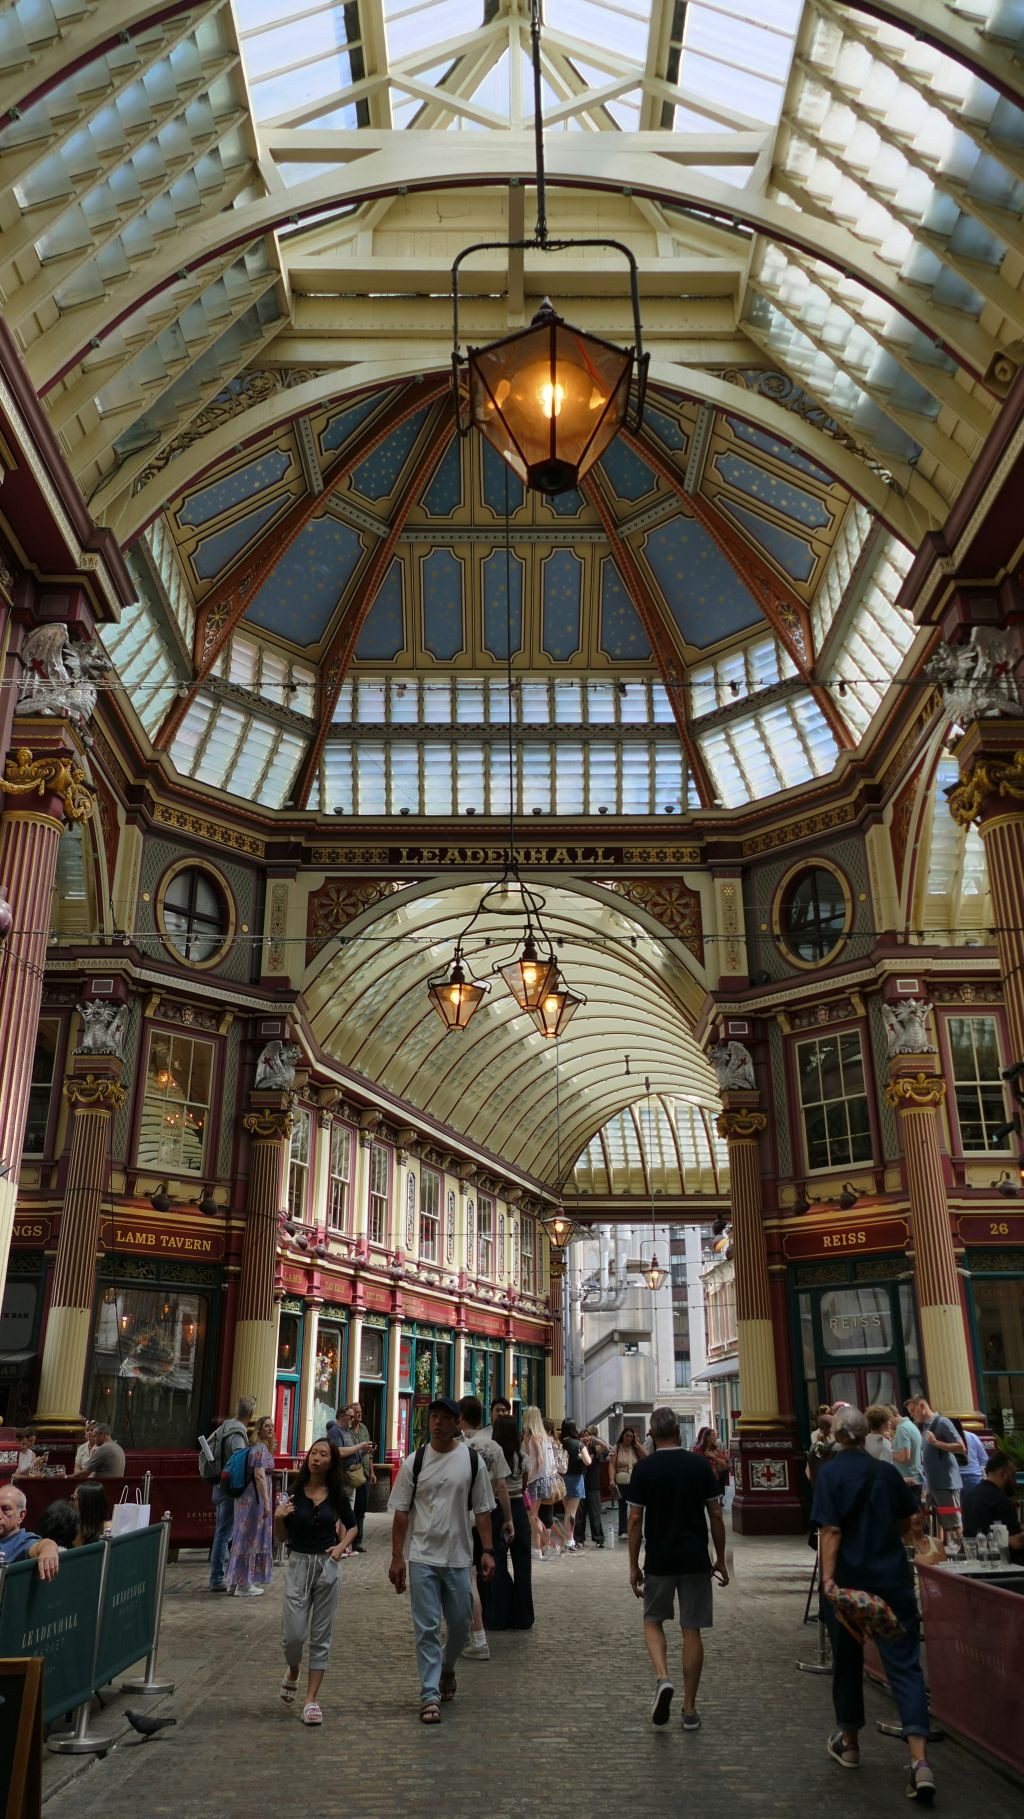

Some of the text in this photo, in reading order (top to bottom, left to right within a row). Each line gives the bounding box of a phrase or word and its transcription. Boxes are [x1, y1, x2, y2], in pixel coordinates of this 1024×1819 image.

[399, 847, 615, 864] LEADENHALL
[990, 1223, 1009, 1235] 26
[116, 1230, 212, 1252] LAMB TAVERN
[823, 1231, 867, 1248] REISS
[283, 1271, 303, 1285] LAMB
[829, 1315, 881, 1330] REISS
[22, 1611, 78, 1649] LEADENHALL
